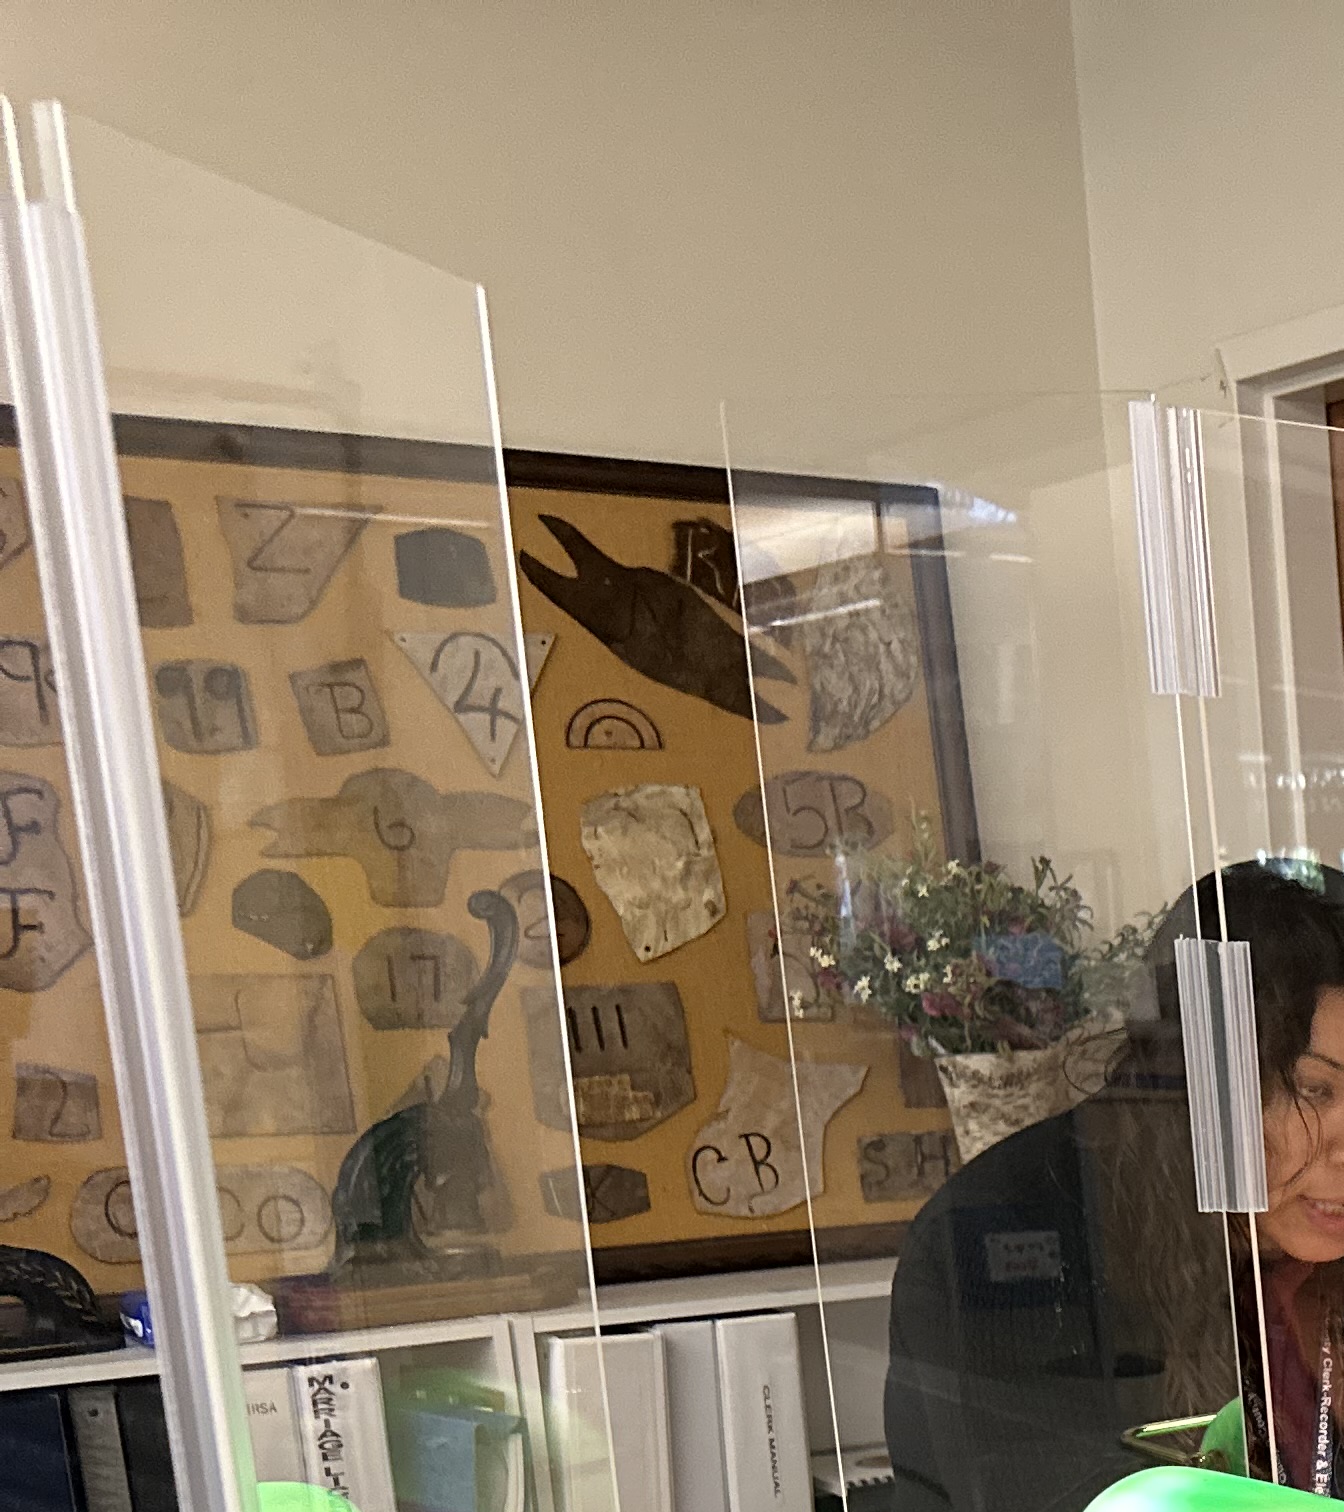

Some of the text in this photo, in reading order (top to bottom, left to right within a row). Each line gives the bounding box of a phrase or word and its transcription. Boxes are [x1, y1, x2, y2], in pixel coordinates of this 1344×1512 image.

[762, 1384, 782, 1499] CLERK MANUAL
[1316, 1356, 1333, 1457] Clerk-Recorder
[1315, 1459, 1329, 1471] &
